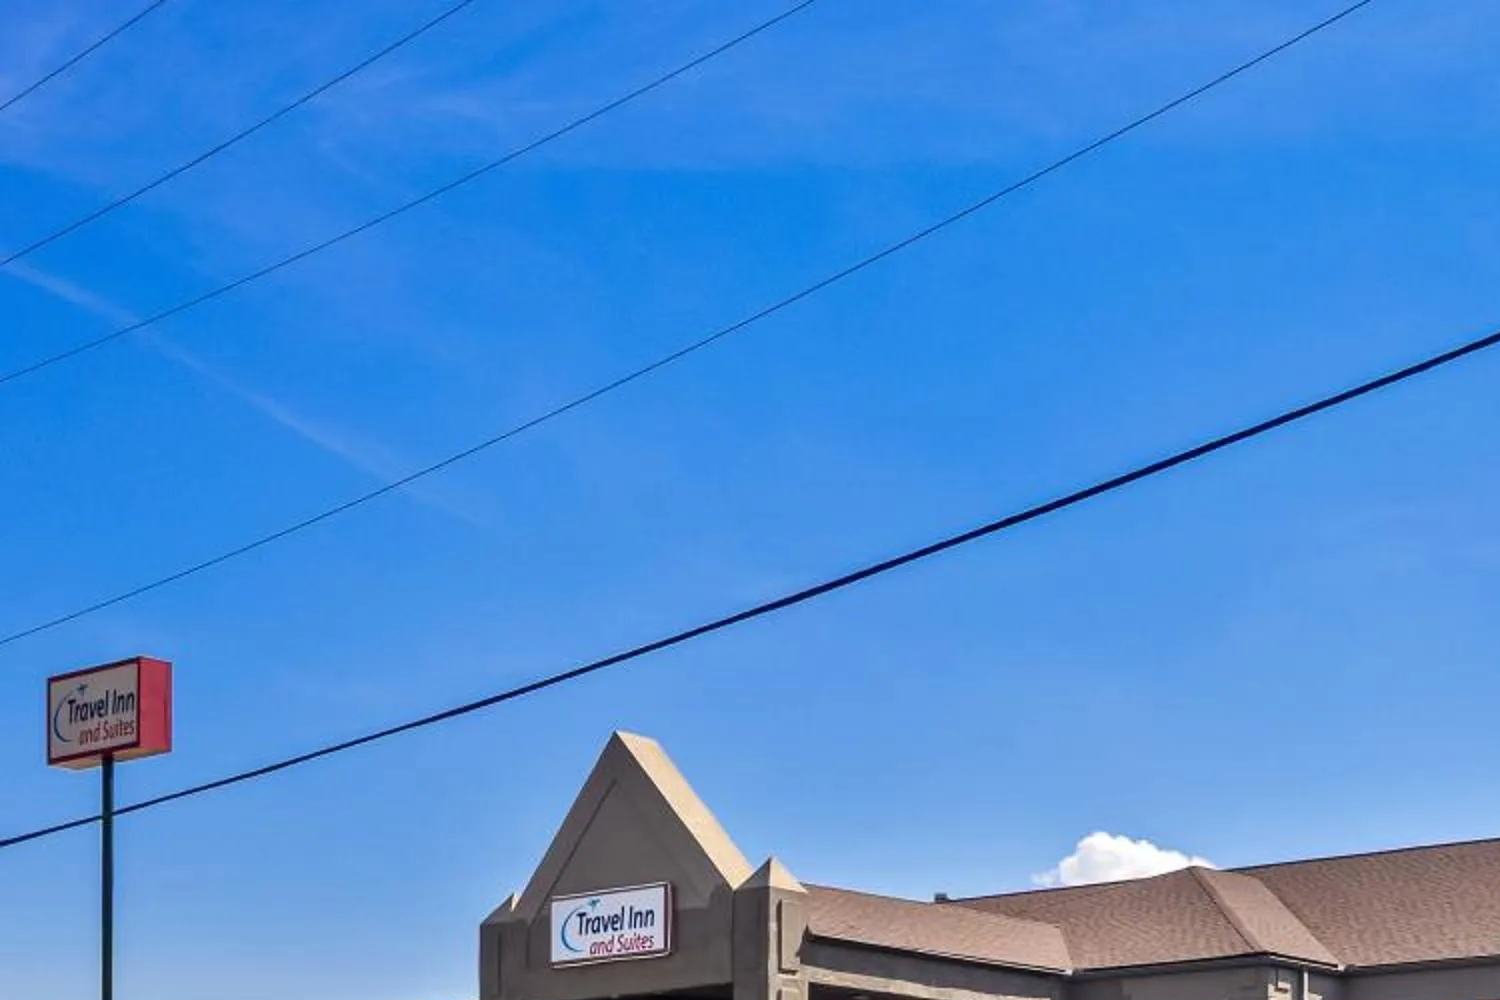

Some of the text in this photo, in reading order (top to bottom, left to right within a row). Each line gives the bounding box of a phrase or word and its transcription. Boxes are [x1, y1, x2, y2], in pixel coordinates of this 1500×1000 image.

[67, 687, 135, 724] Travel Inn
[79, 718, 135, 745] and Suites
[576, 905, 655, 936] Travel Inn
[589, 931, 655, 955] and Suites
